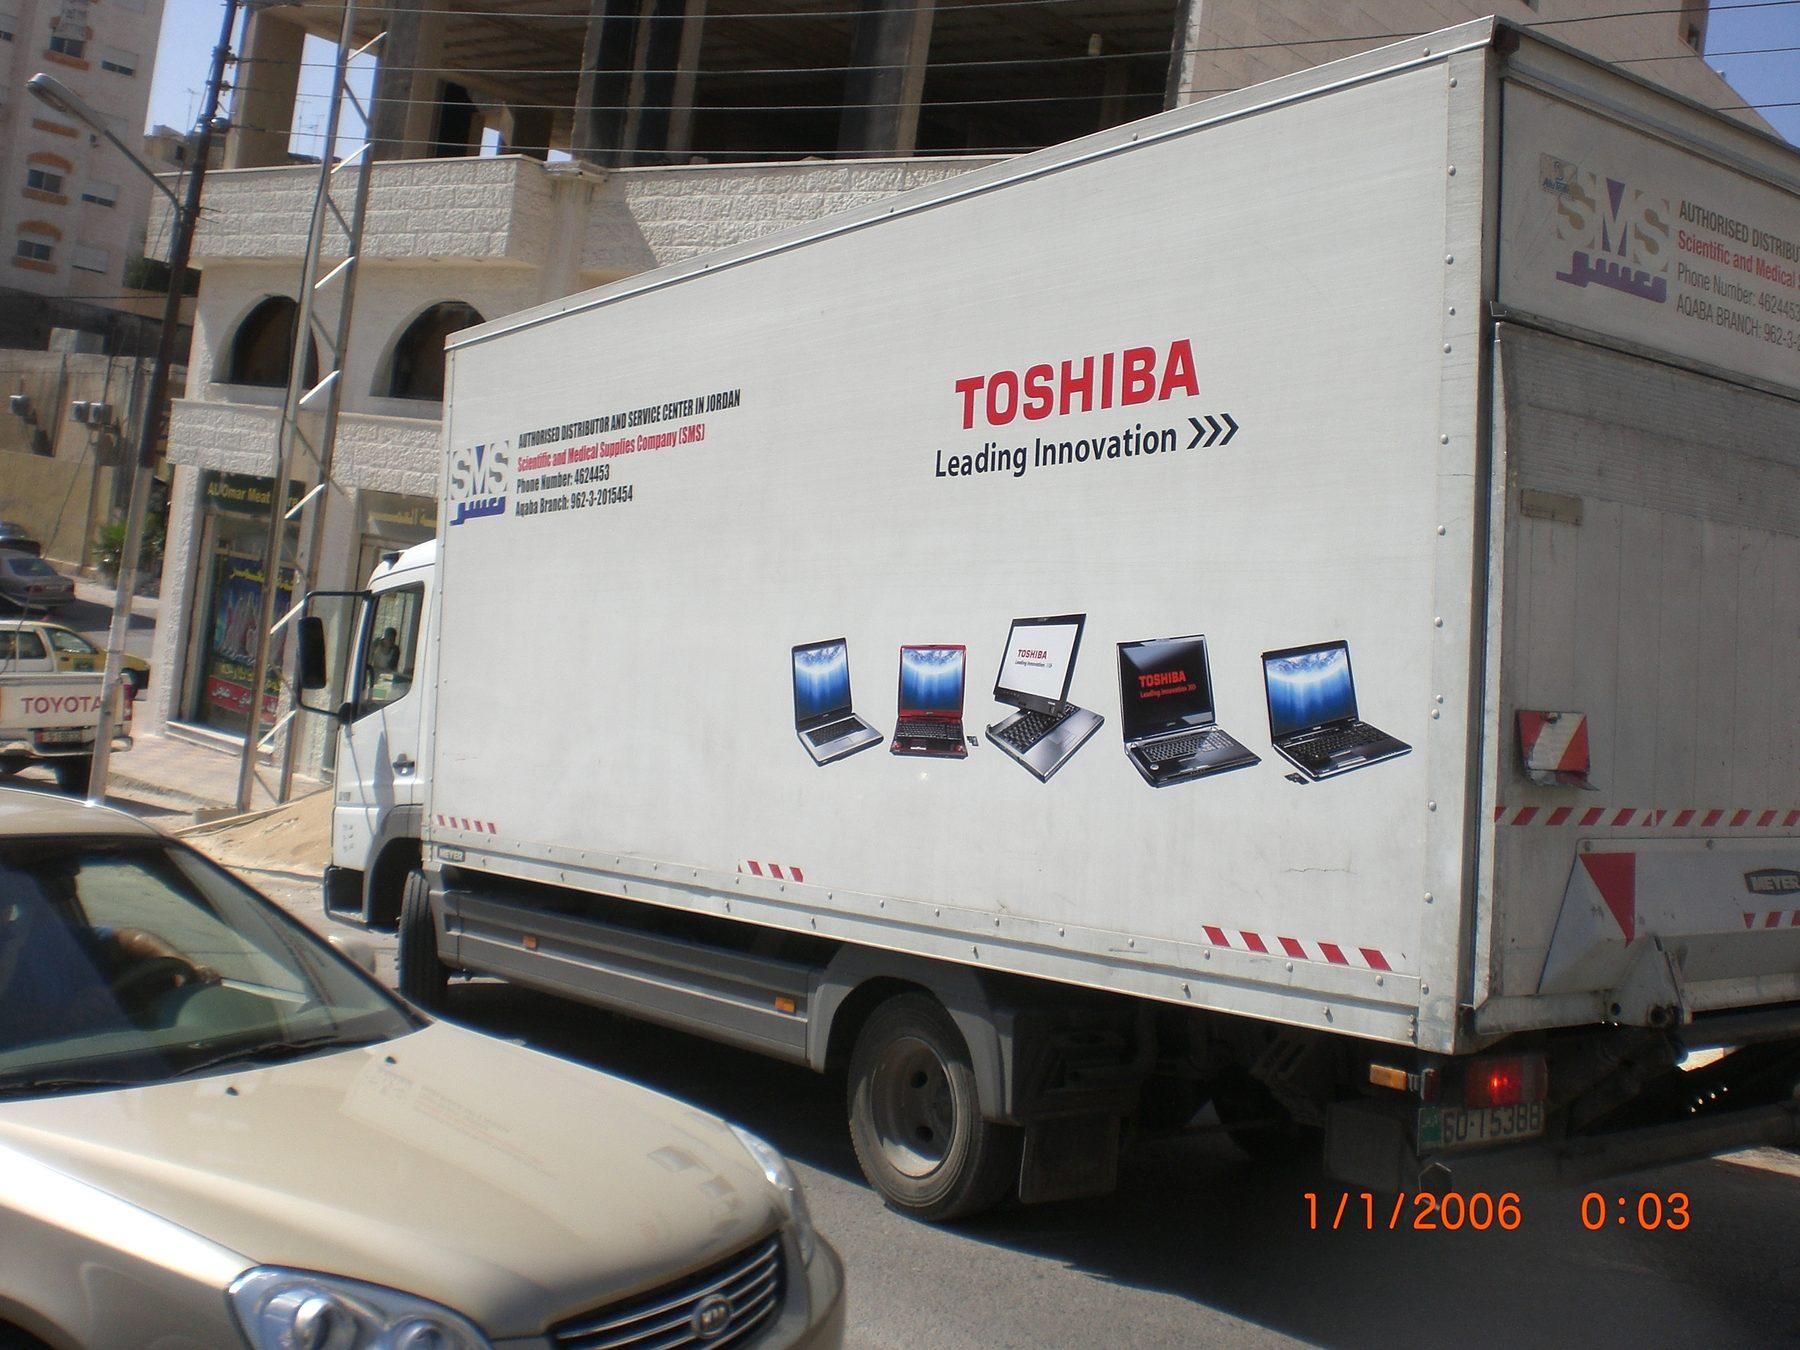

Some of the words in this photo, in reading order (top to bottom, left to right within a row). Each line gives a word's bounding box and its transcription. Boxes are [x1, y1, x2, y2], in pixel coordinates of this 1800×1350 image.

[1556, 168, 1670, 272] SMS
[1679, 200, 1749, 243] AUTHORISED
[1678, 229, 1730, 265] Scientific
[1733, 252, 1753, 272] and
[1756, 257, 1795, 288] Medical
[1677, 262, 1710, 291] Phone
[1713, 274, 1756, 306] Number:
[1676, 294, 1714, 323] AQABA
[956, 338, 1199, 430] TOSHIBA
[518, 426, 560, 449] AUTHORISED
[561, 416, 610, 441] DISTRIBUTOR
[611, 412, 627, 431] AND
[628, 405, 661, 428] SERVICE
[662, 398, 693, 421] CENTER
[695, 396, 705, 415] IN
[706, 388, 741, 412] JORDAN
[451, 440, 509, 500] SMS
[517, 451, 551, 472] Scientific
[552, 449, 567, 466] and
[568, 442, 598, 463] Medical
[600, 437, 635, 459] Supplies
[636, 434, 678, 452] Company
[935, 442, 1028, 478] Leading
[1034, 423, 1177, 467] Innovation
[517, 477, 540, 494] Phone
[541, 471, 573, 491] Number:
[574, 463, 610, 485] 4624453
[516, 500, 538, 517] Aqaba
[539, 495, 569, 514] Branch:
[570, 484, 634, 509] 962-3-2015454
[1017, 649, 1048, 660] TOSHIBA
[1138, 670, 1187, 688] TOSHIBA
[21, 696, 102, 714] TOYOTA
